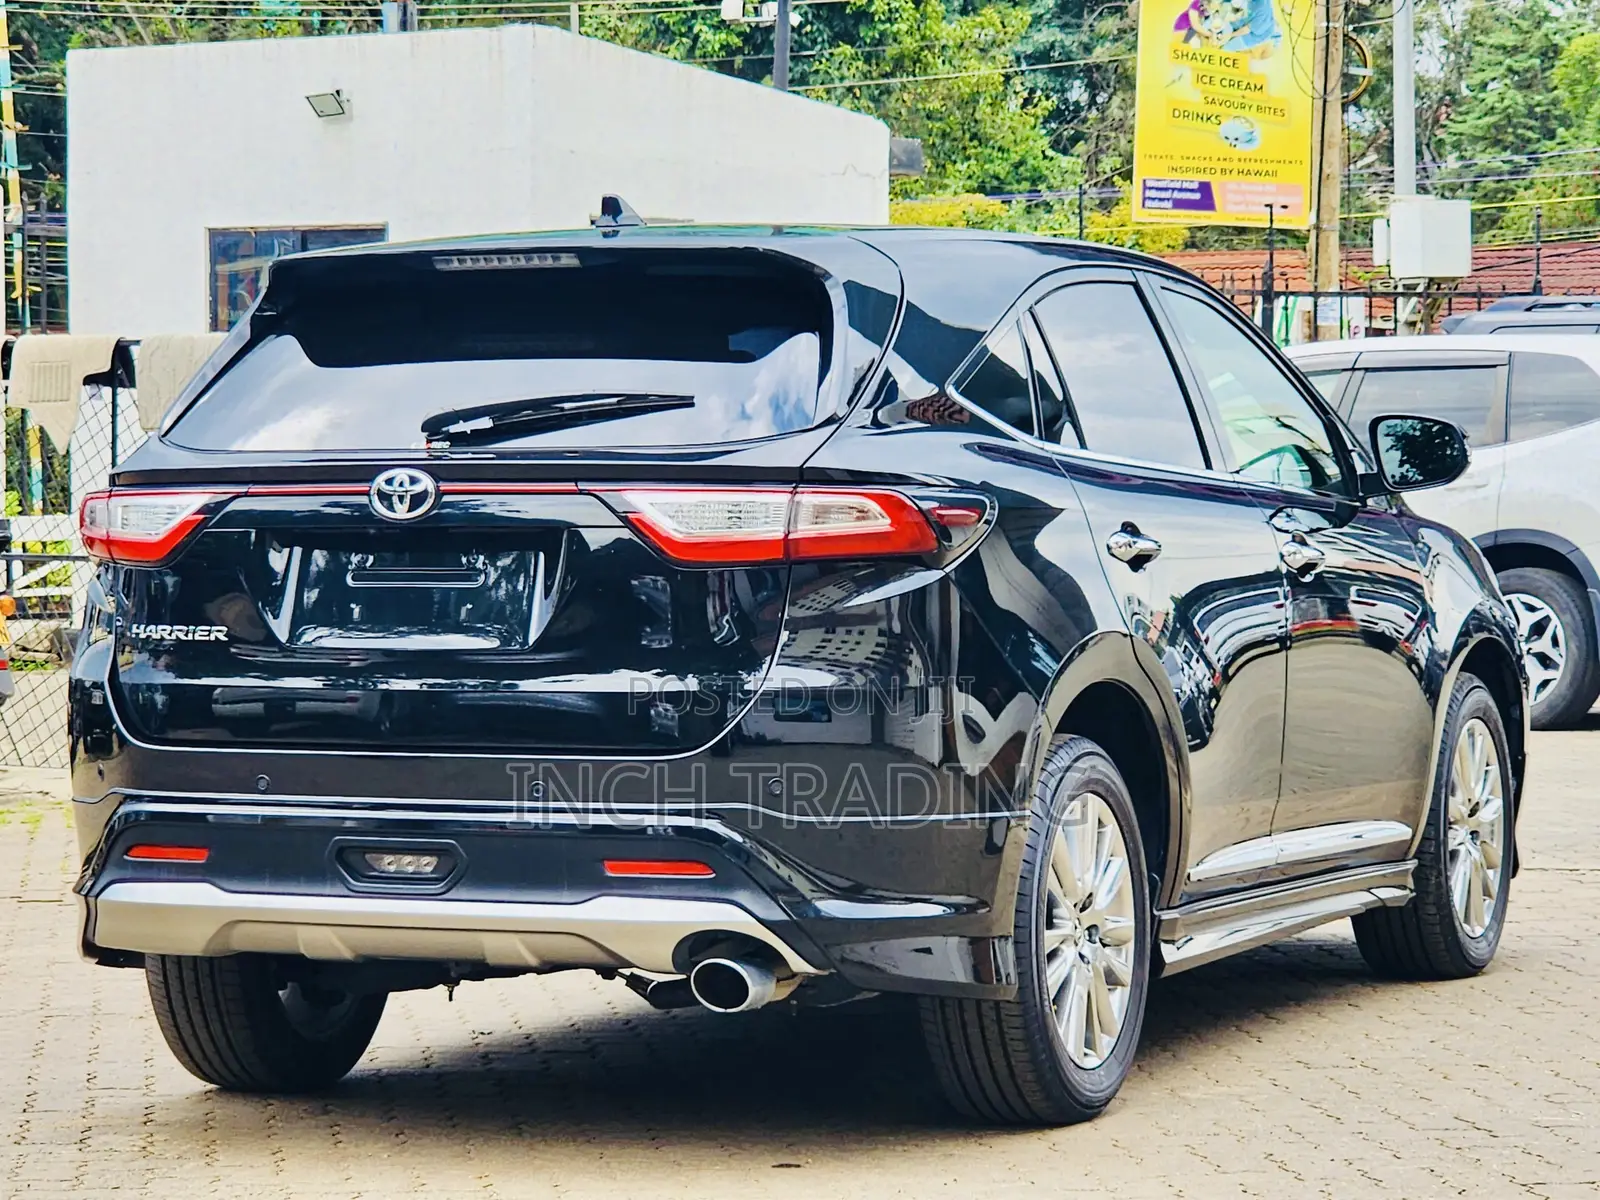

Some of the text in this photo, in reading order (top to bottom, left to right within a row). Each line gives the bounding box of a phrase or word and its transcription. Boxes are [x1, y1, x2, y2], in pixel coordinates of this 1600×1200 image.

[1172, 48, 1241, 70] SHAVE ICE
[1196, 73, 1265, 94] ICE CREAM
[1172, 107, 1223, 126] DRINKS
[1203, 95, 1287, 119] SAVOURY BITES
[1167, 165, 1279, 178] INSPIRED BY HAWAII
[131, 623, 229, 641] HARRIER
